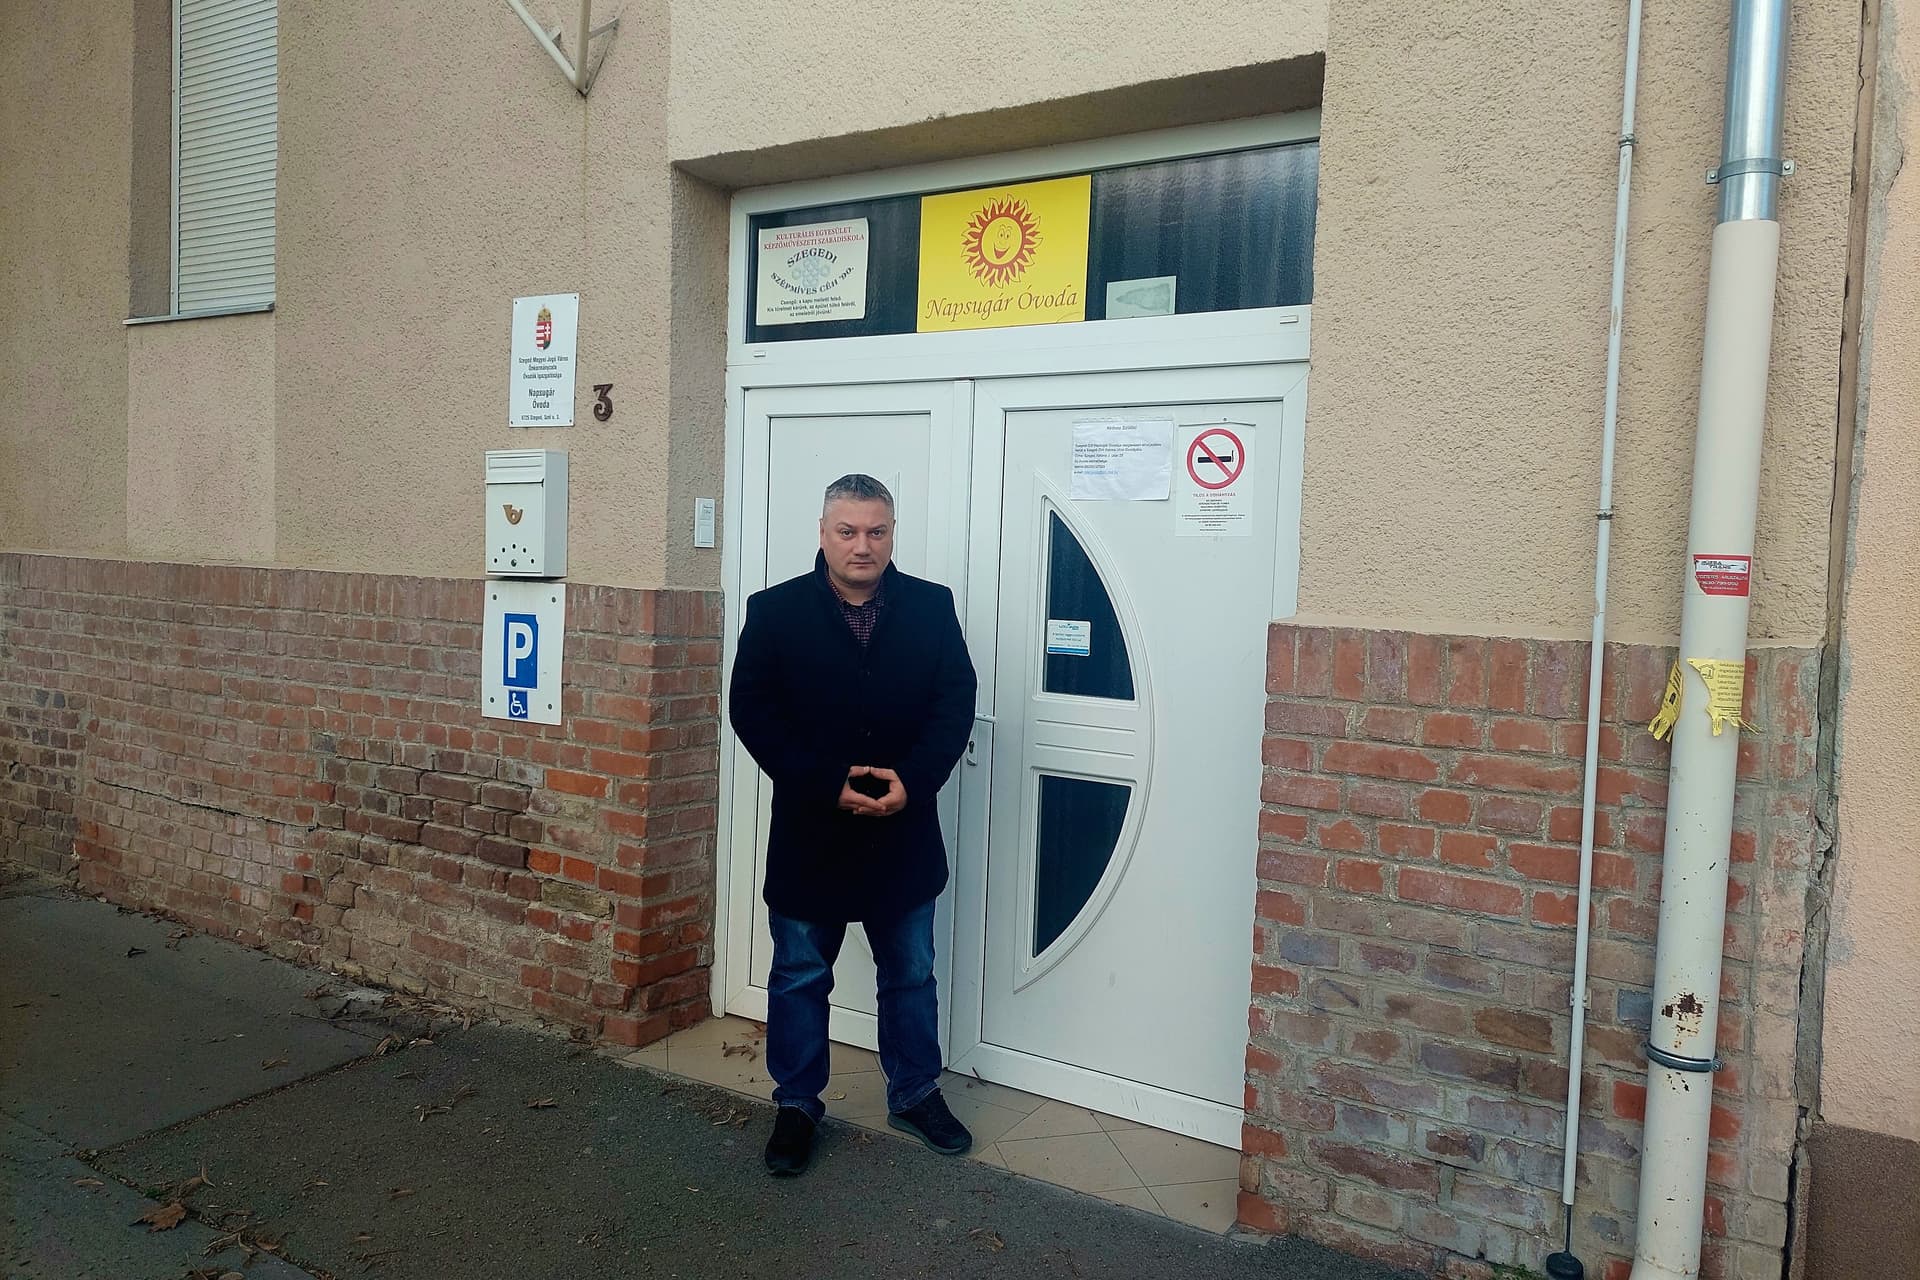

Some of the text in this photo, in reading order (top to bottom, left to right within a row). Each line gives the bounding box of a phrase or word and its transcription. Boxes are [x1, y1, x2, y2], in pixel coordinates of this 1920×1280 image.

[776, 226, 852, 241] KULTURÁLIS EGYESÜLET
[818, 233, 864, 245] SZABADISKOLA
[787, 247, 838, 268] SZEGEDI
[770, 272, 818, 295] SZÉPMÍVES
[925, 284, 1078, 323] Napsugár Óvoda
[528, 387, 555, 398] Napsugár
[593, 383, 614, 422] 3
[532, 398, 550, 409] Óvoda
[507, 621, 534, 679] P
